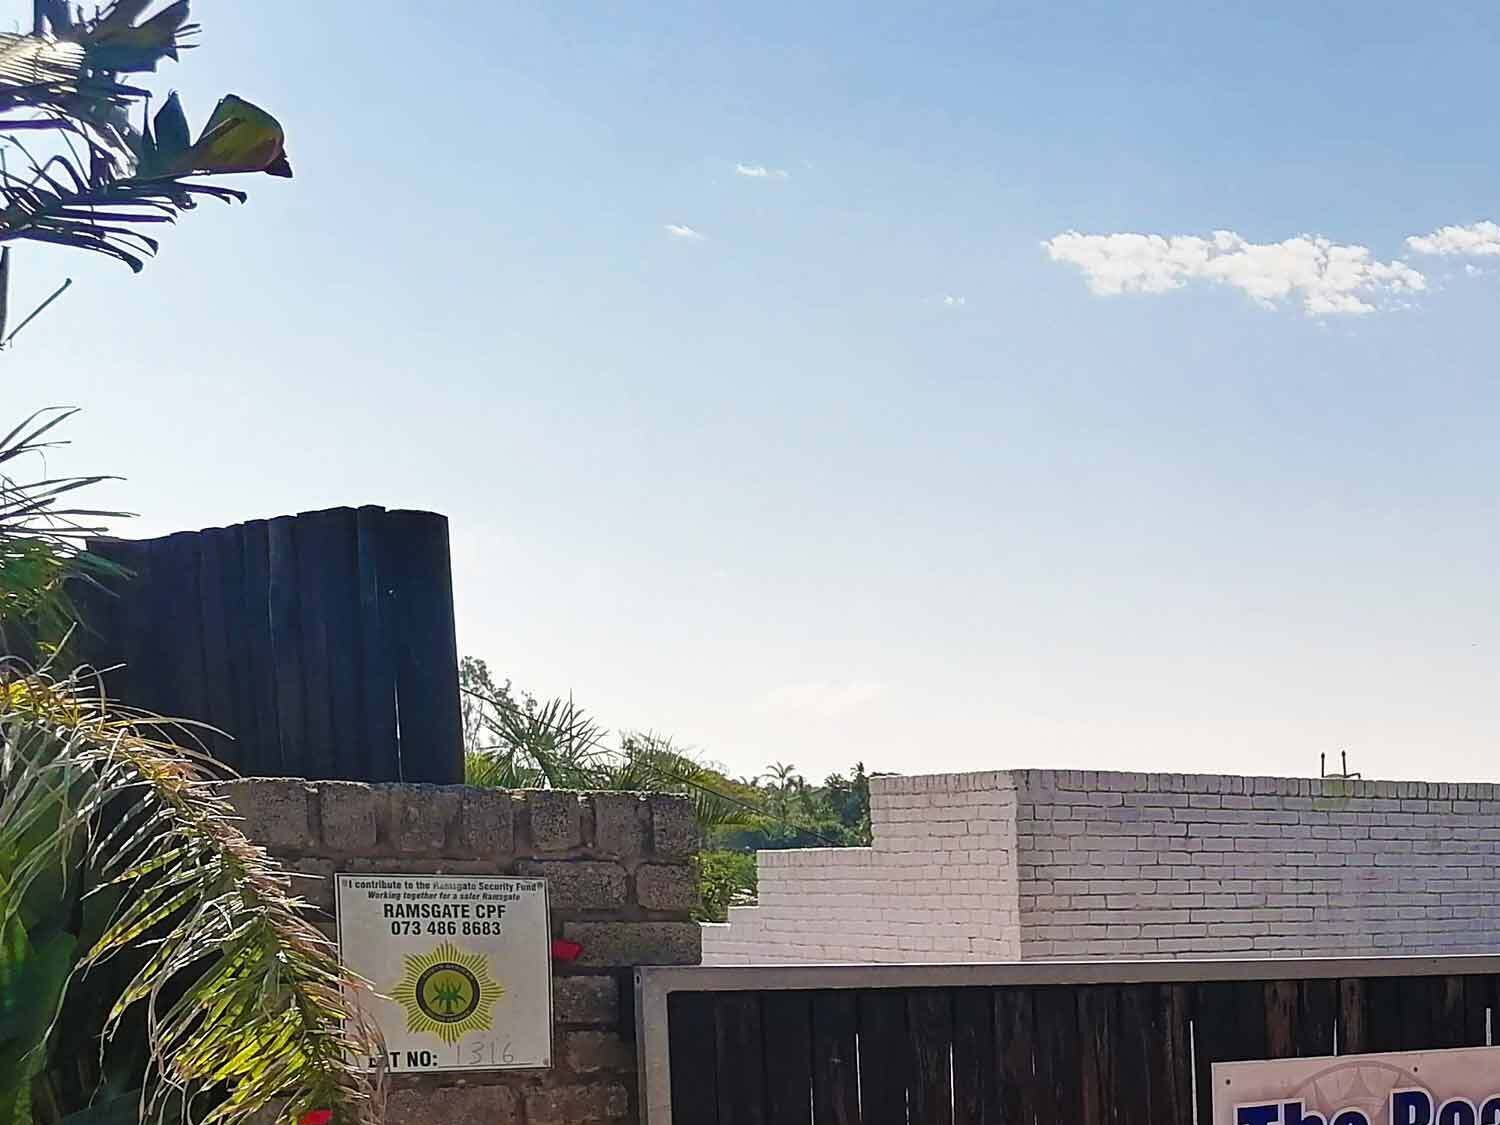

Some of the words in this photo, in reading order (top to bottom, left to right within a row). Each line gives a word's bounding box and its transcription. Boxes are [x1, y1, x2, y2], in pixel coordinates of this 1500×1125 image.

[354, 880, 402, 889] contribute
[404, 880, 414, 890] to
[416, 880, 431, 890] the
[478, 882, 514, 892] Security
[367, 891, 401, 901] Working
[403, 891, 438, 901] together
[439, 892, 450, 901] for
[460, 892, 480, 901] safer
[482, 893, 521, 902] Ramsgate
[383, 903, 470, 919] RAMSGATE
[475, 904, 507, 919] CPF
[391, 921, 421, 936] 073
[426, 921, 457, 936] 486
[462, 921, 501, 936] 8683
[407, 1050, 438, 1068] NO:
[456, 1041, 515, 1065] 1316
